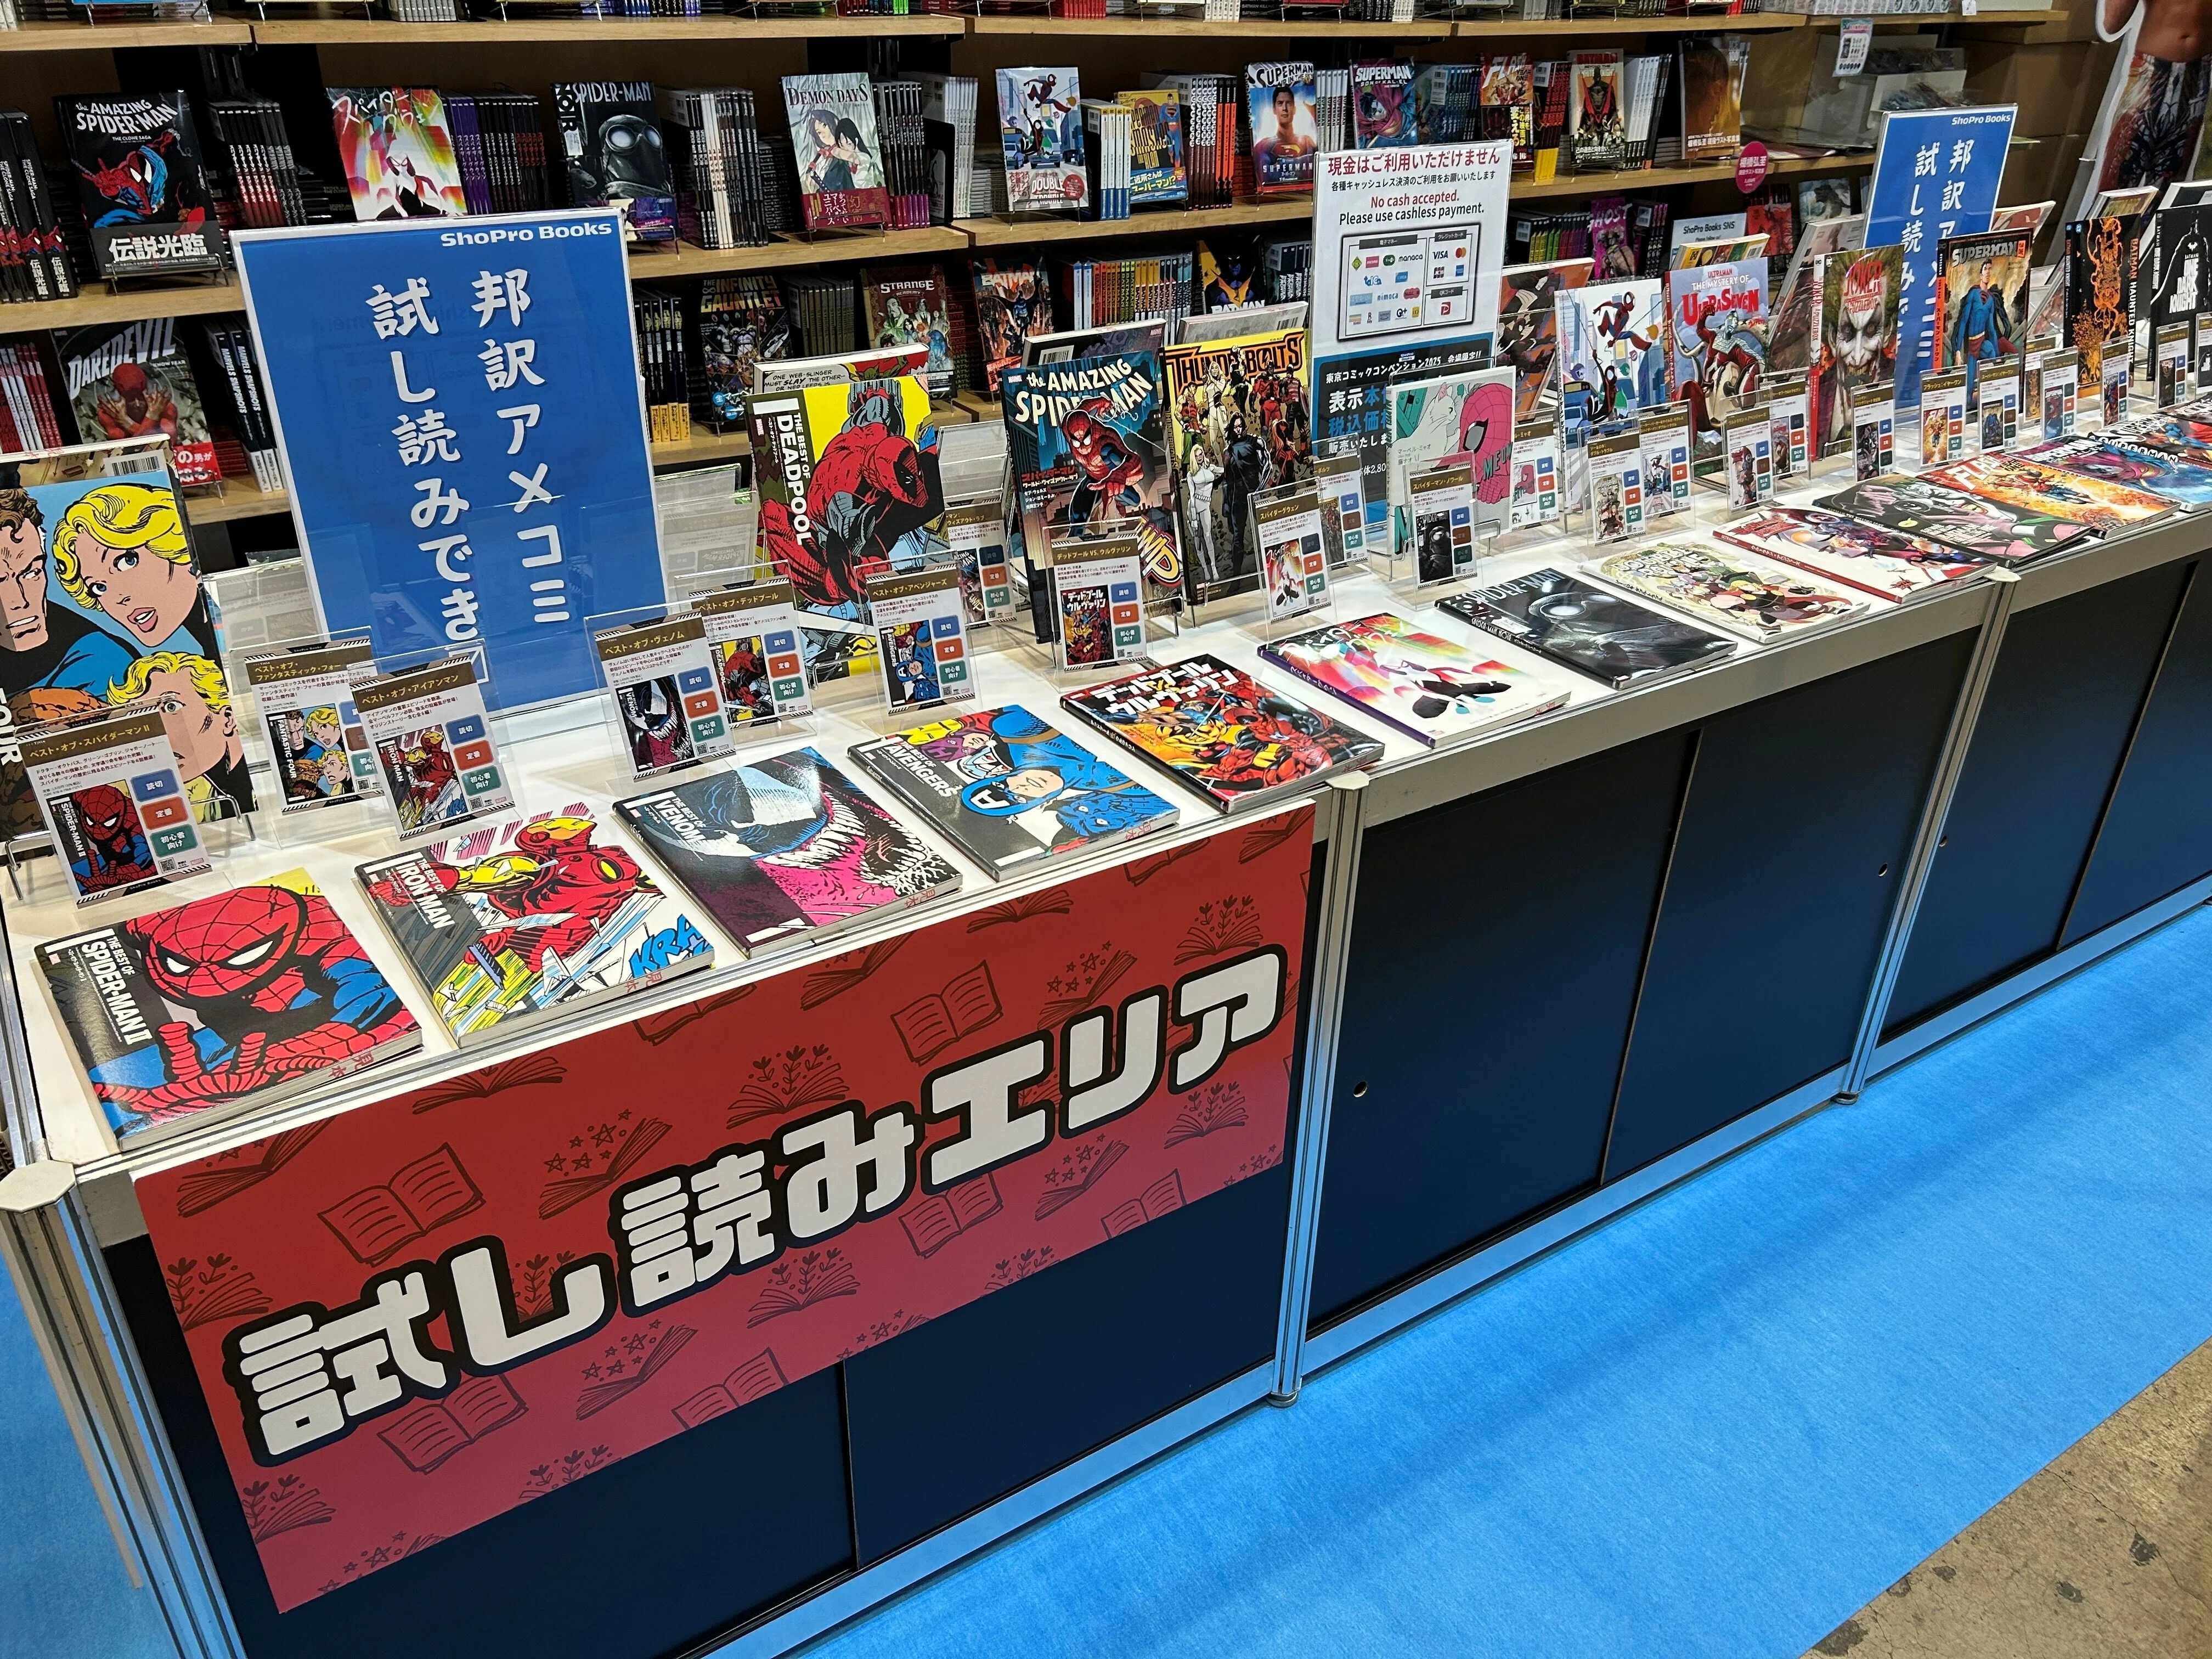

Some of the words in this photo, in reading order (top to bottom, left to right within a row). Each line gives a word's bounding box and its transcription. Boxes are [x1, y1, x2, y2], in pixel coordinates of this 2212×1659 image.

[1249, 64, 1314, 88] SUPERMAN
[1356, 65, 1412, 82] SUPERMAN
[573, 82, 653, 103] SPIDER-MAN
[786, 88, 834, 108] DEMON
[838, 83, 868, 103] DAYS
[76, 103, 89, 111] the
[91, 99, 152, 115] AMAZING
[1952, 115, 1984, 126] ShoPro
[1985, 114, 2011, 123] Books
[1263, 163, 1313, 172] SUPERMAN
[1328, 148, 1500, 176] 現金はご利用いただけません
[1031, 177, 1065, 192] DOUBLE
[1331, 171, 1496, 191] 各種キャッシュレス決済のご利用をお願いいたします
[1371, 196, 1384, 208] No
[1387, 194, 1409, 206] cash
[1413, 189, 1460, 205] accepted.
[1340, 213, 1373, 225] Please
[1375, 212, 1392, 222] use
[1395, 206, 1436, 220] cashless
[1438, 203, 1484, 219] payment.
[442, 228, 534, 247] ShoPro
[540, 223, 612, 239] Books
[1683, 226, 1703, 234] ShoPro
[1723, 221, 1735, 229] SNS
[109, 233, 208, 262] 伝説光臨
[1432, 250, 1448, 259] VISA
[1952, 241, 2018, 267] SUPERMAN
[2129, 238, 2139, 280] BATMAN
[2184, 258, 2199, 276] ONE
[30, 259, 49, 295] 伝説光臨
[52, 257, 69, 293] 伝説光臨
[716, 275, 776, 291] INFINITY
[1691, 282, 1706, 291] THE
[1707, 276, 1738, 289] MYSTERY
[1740, 275, 1749, 283] OF
[1708, 268, 1733, 278] ULTRAMAN
[881, 280, 935, 294] STRANGE
[2177, 276, 2198, 294] DARK
[701, 290, 782, 313] GAUNTLET
[2129, 281, 2138, 326] HAUNTED
[2169, 292, 2198, 314] KNIGHT
[2128, 329, 2136, 364] KNIGHT
[68, 316, 177, 400] DAREDEVIL
[789, 369, 832, 379] WEB-SLINGER
[1026, 372, 1046, 387] the
[1048, 358, 1132, 391] AMAZING
[794, 413, 803, 433] THE
[471, 268, 570, 623] 邦訳アメコミ
[797, 435, 808, 462] BEST
[1398, 444, 1431, 454] マーベル・ミャオ
[777, 415, 812, 545] DEADPOOL
[802, 464, 811, 479] OF
[1413, 475, 1463, 490] スパイダーマン・ノワール
[1260, 505, 1299, 520] スパイダーグウェン
[1057, 551, 1087, 560] デッドプール
[1100, 546, 1131, 555] ウルヴァリン
[872, 578, 947, 596] ベスト・オブ・アベンジャーズ
[1462, 569, 1568, 606] SPIDER-MAN
[698, 592, 778, 611] ベスト・オブ・デッドプール
[1066, 598, 1106, 611] ウルヴァリン
[605, 631, 685, 654] ベスト・オブ・ヴェノム
[1498, 630, 1513, 642] NOIR
[887, 633, 897, 668] AVENGERS
[255, 662, 298, 673] ベスト・オブ・
[256, 664, 341, 681] ファンタスティック・フォー
[362, 675, 459, 705] ベスト・オブ・アイアンマン
[689, 676, 702, 685] 読切
[1090, 661, 1215, 702] デッドプール
[1104, 669, 1240, 715] ウルヴァリン
[625, 692, 637, 718] VENOM
[458, 725, 473, 734] 読切
[697, 720, 716, 731] 初心者
[277, 719, 292, 758] FANTASTIC
[287, 758, 297, 779] FOUR
[466, 751, 481, 759] 定番
[900, 741, 914, 752] THE
[911, 748, 930, 761] BEST
[924, 760, 937, 768] OF
[387, 746, 398, 764] IRON
[393, 764, 404, 783] MAN
[885, 745, 963, 798] AVENGERS
[146, 780, 163, 791] 読切
[470, 773, 491, 783] 初心者
[476, 780, 489, 789] 向け
[155, 808, 173, 819] 定番
[654, 799, 707, 843] VENOM
[672, 797, 685, 809] THE
[680, 807, 699, 822] BEST
[693, 820, 707, 828] OF
[61, 802, 84, 851] SPIDER-MAN
[161, 831, 185, 844] 初心者
[167, 839, 183, 850] 向け
[417, 859, 428, 871] THE
[424, 869, 439, 884] BEST
[434, 884, 447, 894] OF
[395, 862, 433, 896] IRON
[416, 894, 455, 929] MAN
[106, 936, 120, 951] THE
[114, 949, 130, 967] BEST
[121, 966, 136, 976] OF
[81, 941, 147, 1034] SPIDER-MAN
[237, 949, 1285, 1458] 試し読みエリア
